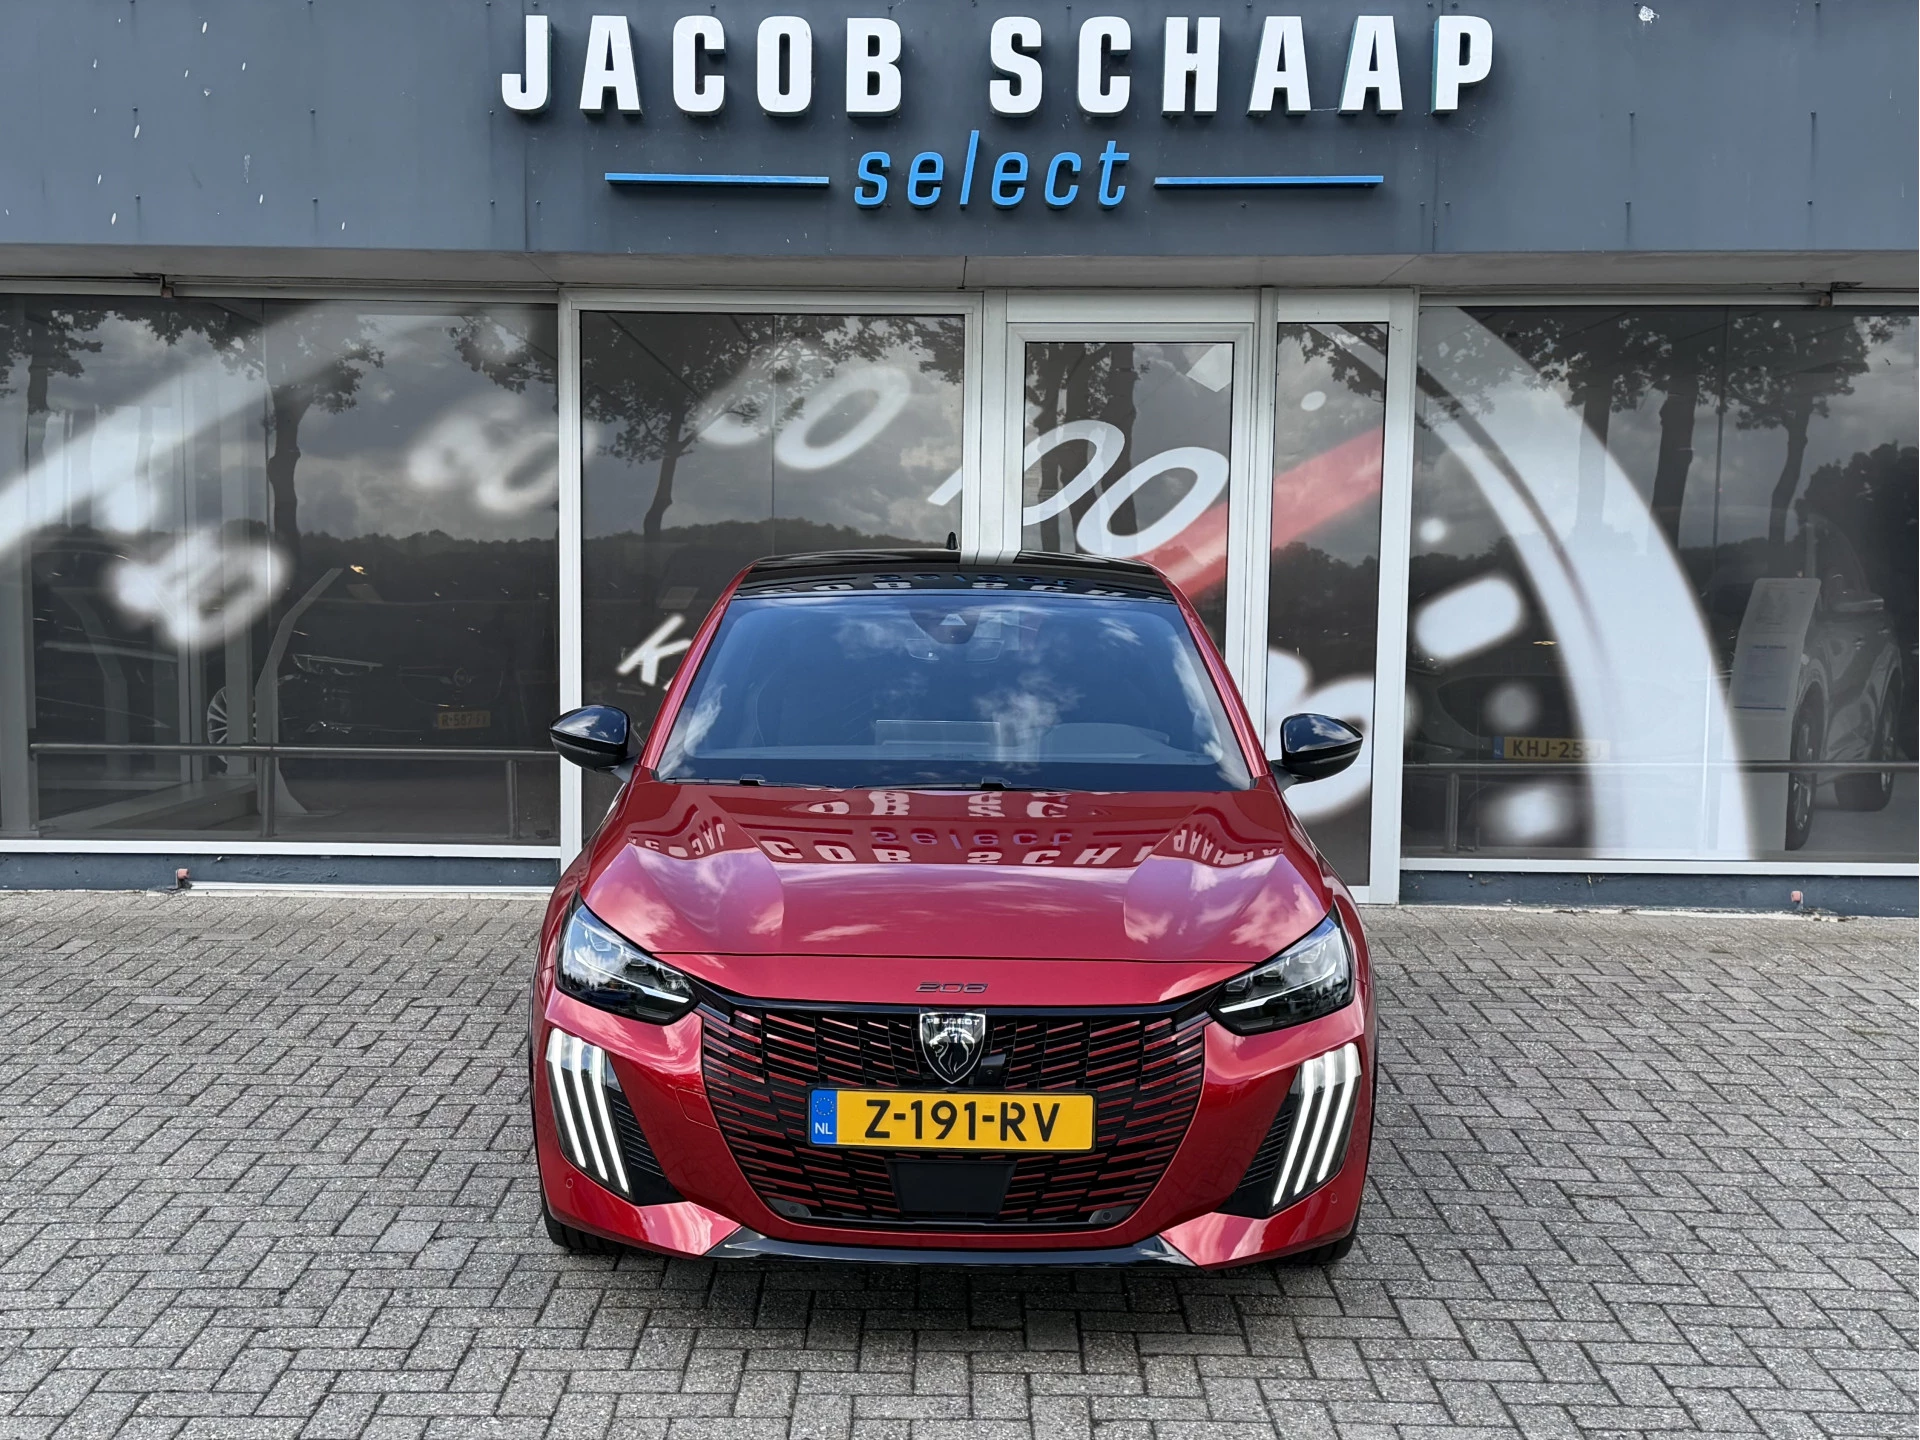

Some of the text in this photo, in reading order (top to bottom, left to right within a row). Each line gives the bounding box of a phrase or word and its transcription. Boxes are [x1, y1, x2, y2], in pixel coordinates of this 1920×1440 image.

[501, 15, 1494, 116] JACOB SCHAAP
[853, 129, 1131, 209] select
[814, 1122, 833, 1135] NL
[864, 1099, 1060, 1142] Z-191-RV
